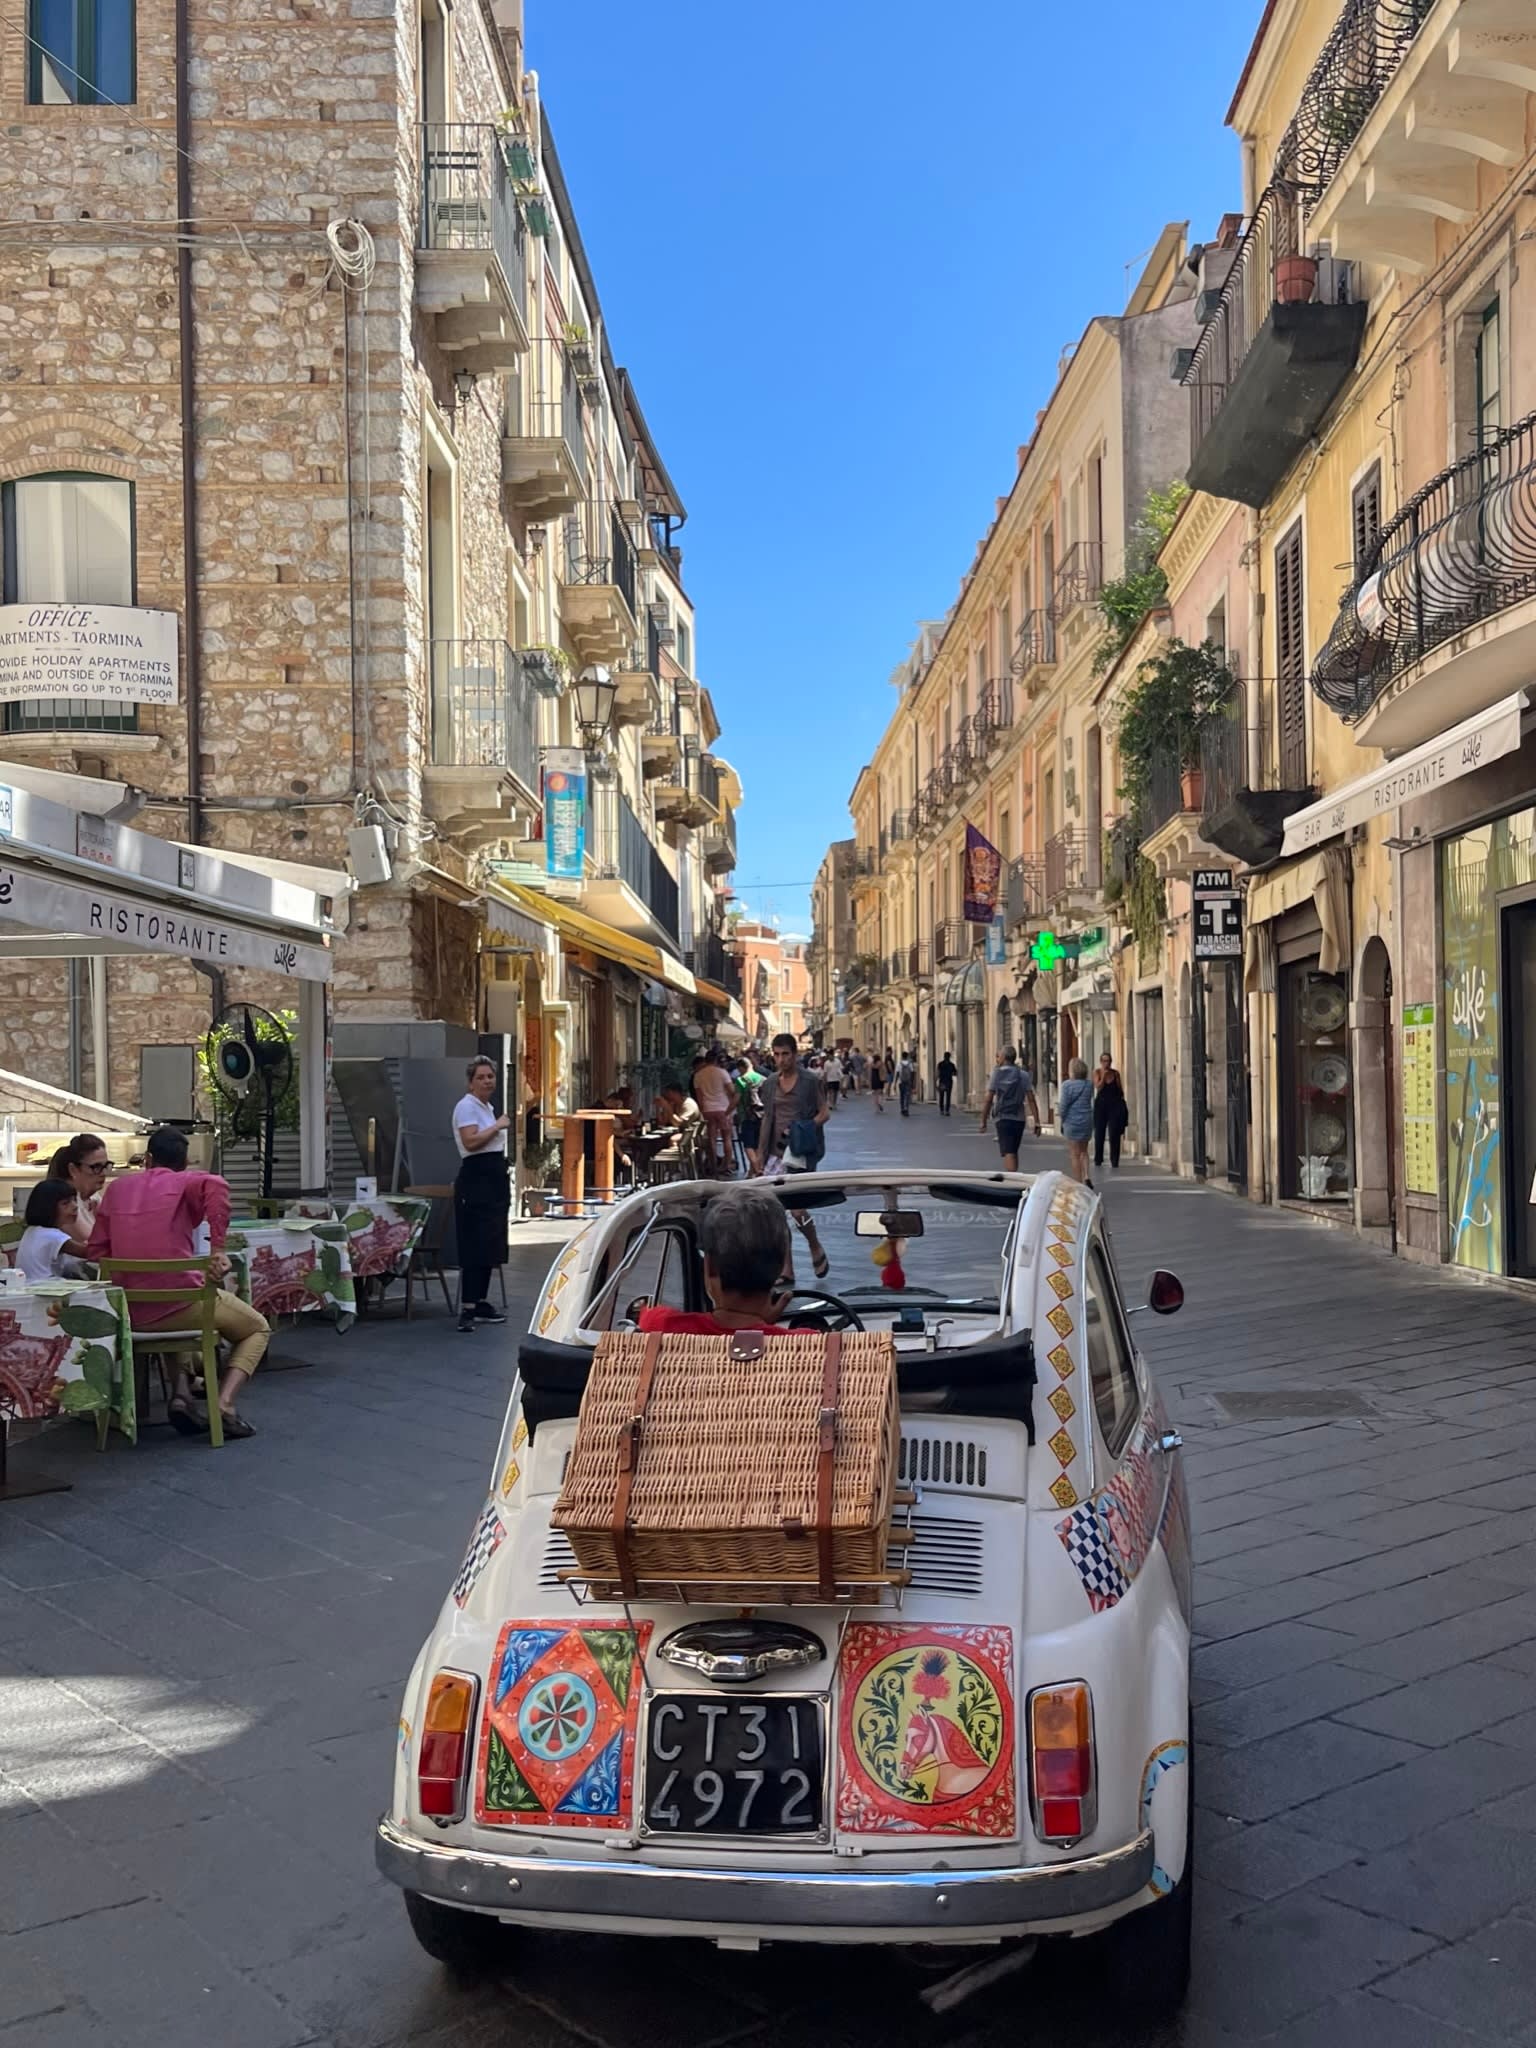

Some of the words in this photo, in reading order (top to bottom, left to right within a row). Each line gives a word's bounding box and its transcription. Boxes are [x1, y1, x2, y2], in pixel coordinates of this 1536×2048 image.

[28, 610, 93, 627] OFFICE
[72, 631, 143, 648] TAORMINA
[32, 655, 83, 666] HOLIDAY
[89, 657, 171, 673] APARTMENTS
[23, 670, 42, 680] AND
[47, 669, 94, 681] OUTSIDE
[99, 671, 115, 681] OF
[120, 671, 173, 687] TAORMINA
[10, 683, 69, 695] INFORMATION
[72, 683, 88, 693] GO
[92, 684, 105, 694] UP
[109, 685, 122, 695] TO
[140, 688, 172, 699] FLOOR
[1304, 820, 1321, 842] BAR
[1374, 757, 1446, 809] RISTORANTE
[1196, 872, 1229, 887] ATM
[1203, 900, 1231, 934] T
[90, 903, 228, 955] RISTORANTE
[1197, 934, 1240, 945] TABACCHI
[653, 1703, 800, 1763] CT31
[650, 1768, 813, 1828] 4972
